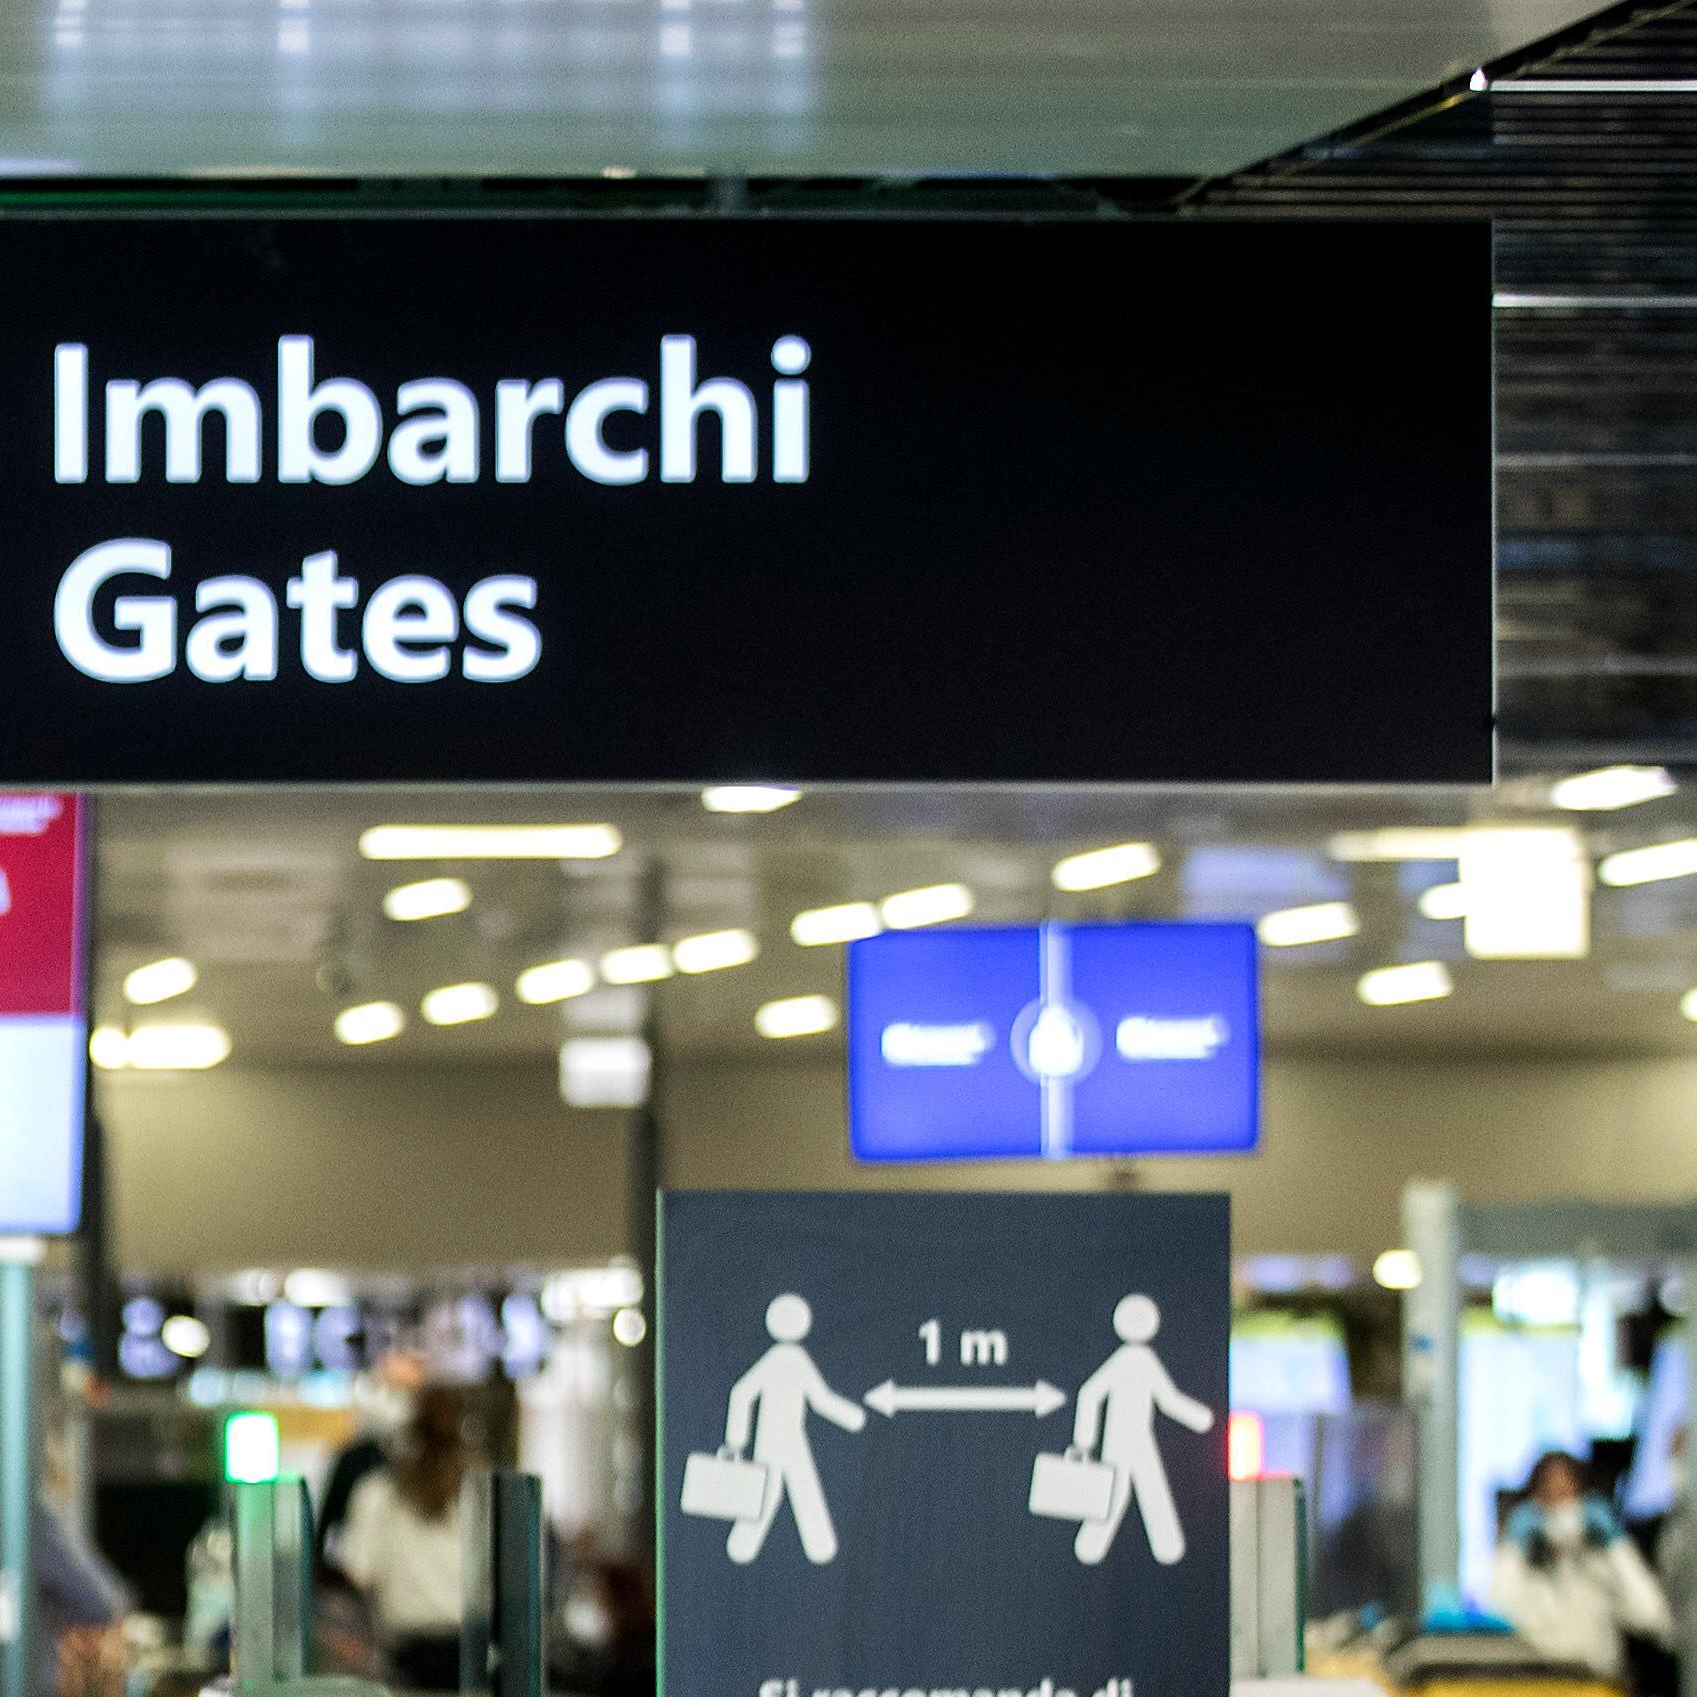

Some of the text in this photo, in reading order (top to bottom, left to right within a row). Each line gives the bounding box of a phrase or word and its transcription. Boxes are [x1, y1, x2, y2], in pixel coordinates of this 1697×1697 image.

[55, 336, 810, 484] Imbarchi
[54, 539, 541, 682] Gates
[920, 1320, 1007, 1364] 1 m
